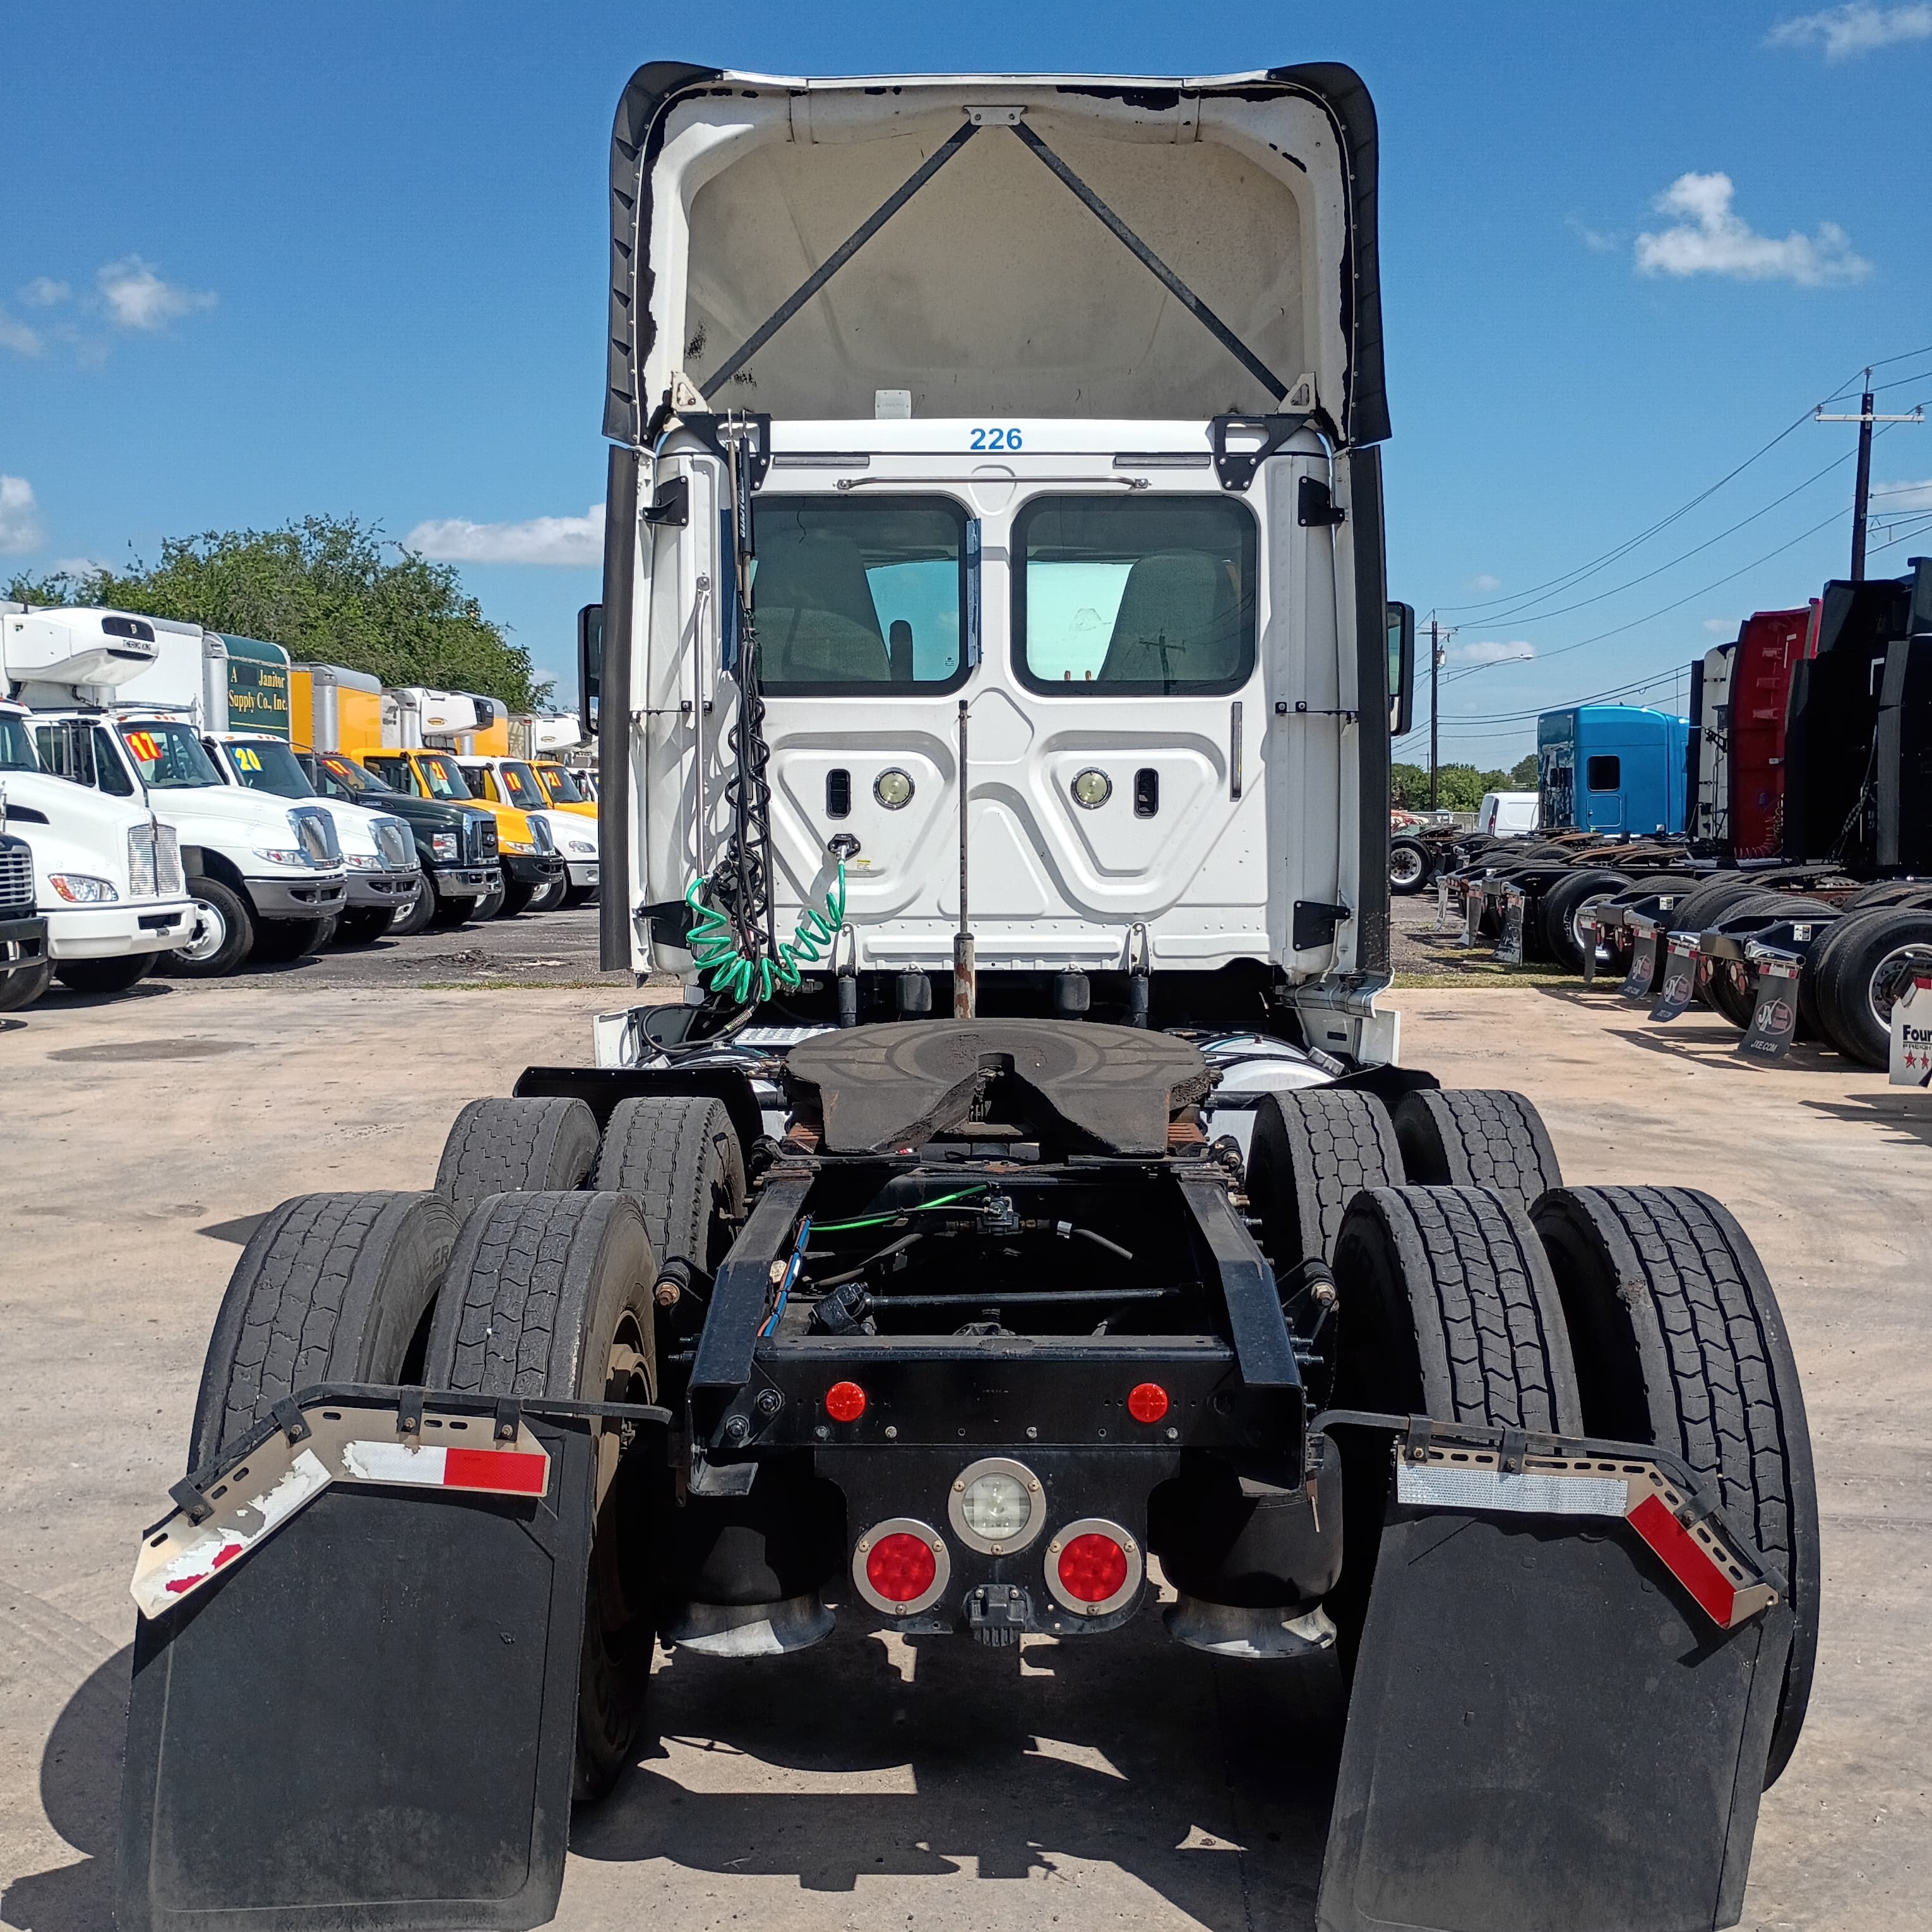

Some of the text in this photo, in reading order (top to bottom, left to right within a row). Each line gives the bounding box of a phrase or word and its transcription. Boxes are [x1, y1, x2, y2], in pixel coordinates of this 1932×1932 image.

[970, 428, 1022, 450] 226
[230, 665, 285, 689] A Janitor
[229, 689, 288, 713] Supply Co., Inc.
[131, 731, 158, 760] 17
[235, 748, 261, 771] 20
[431, 761, 448, 779] 21
[506, 773, 522, 789] 18
[547, 772, 562, 787] 21
[1903, 1024, 1932, 1042] Four
